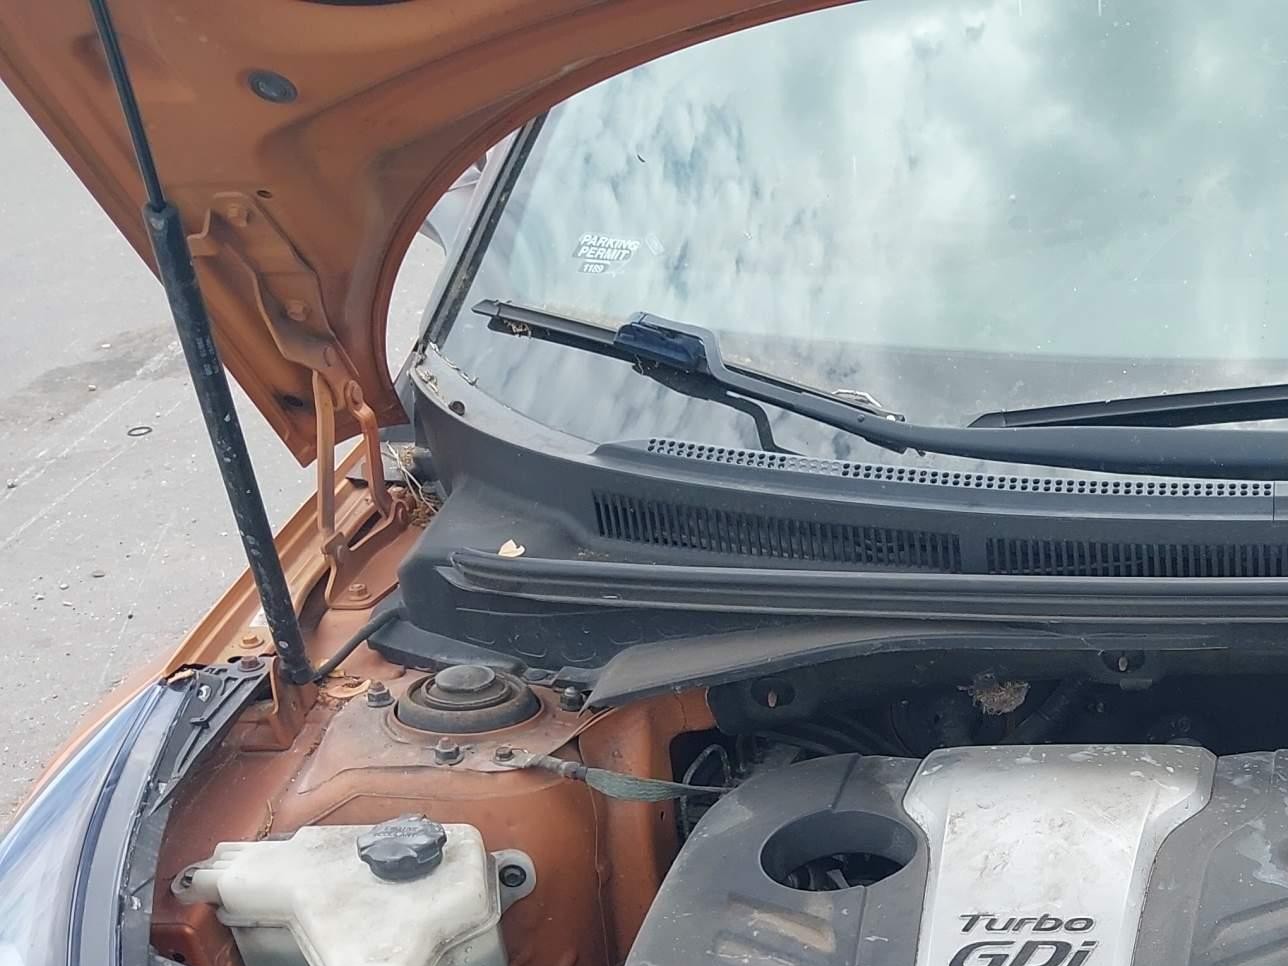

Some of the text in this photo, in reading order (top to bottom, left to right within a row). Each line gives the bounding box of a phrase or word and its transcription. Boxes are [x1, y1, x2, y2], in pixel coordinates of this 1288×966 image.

[579, 234, 640, 251] PARKING
[577, 246, 631, 260] PERMIT
[959, 913, 1095, 933] Turbo
